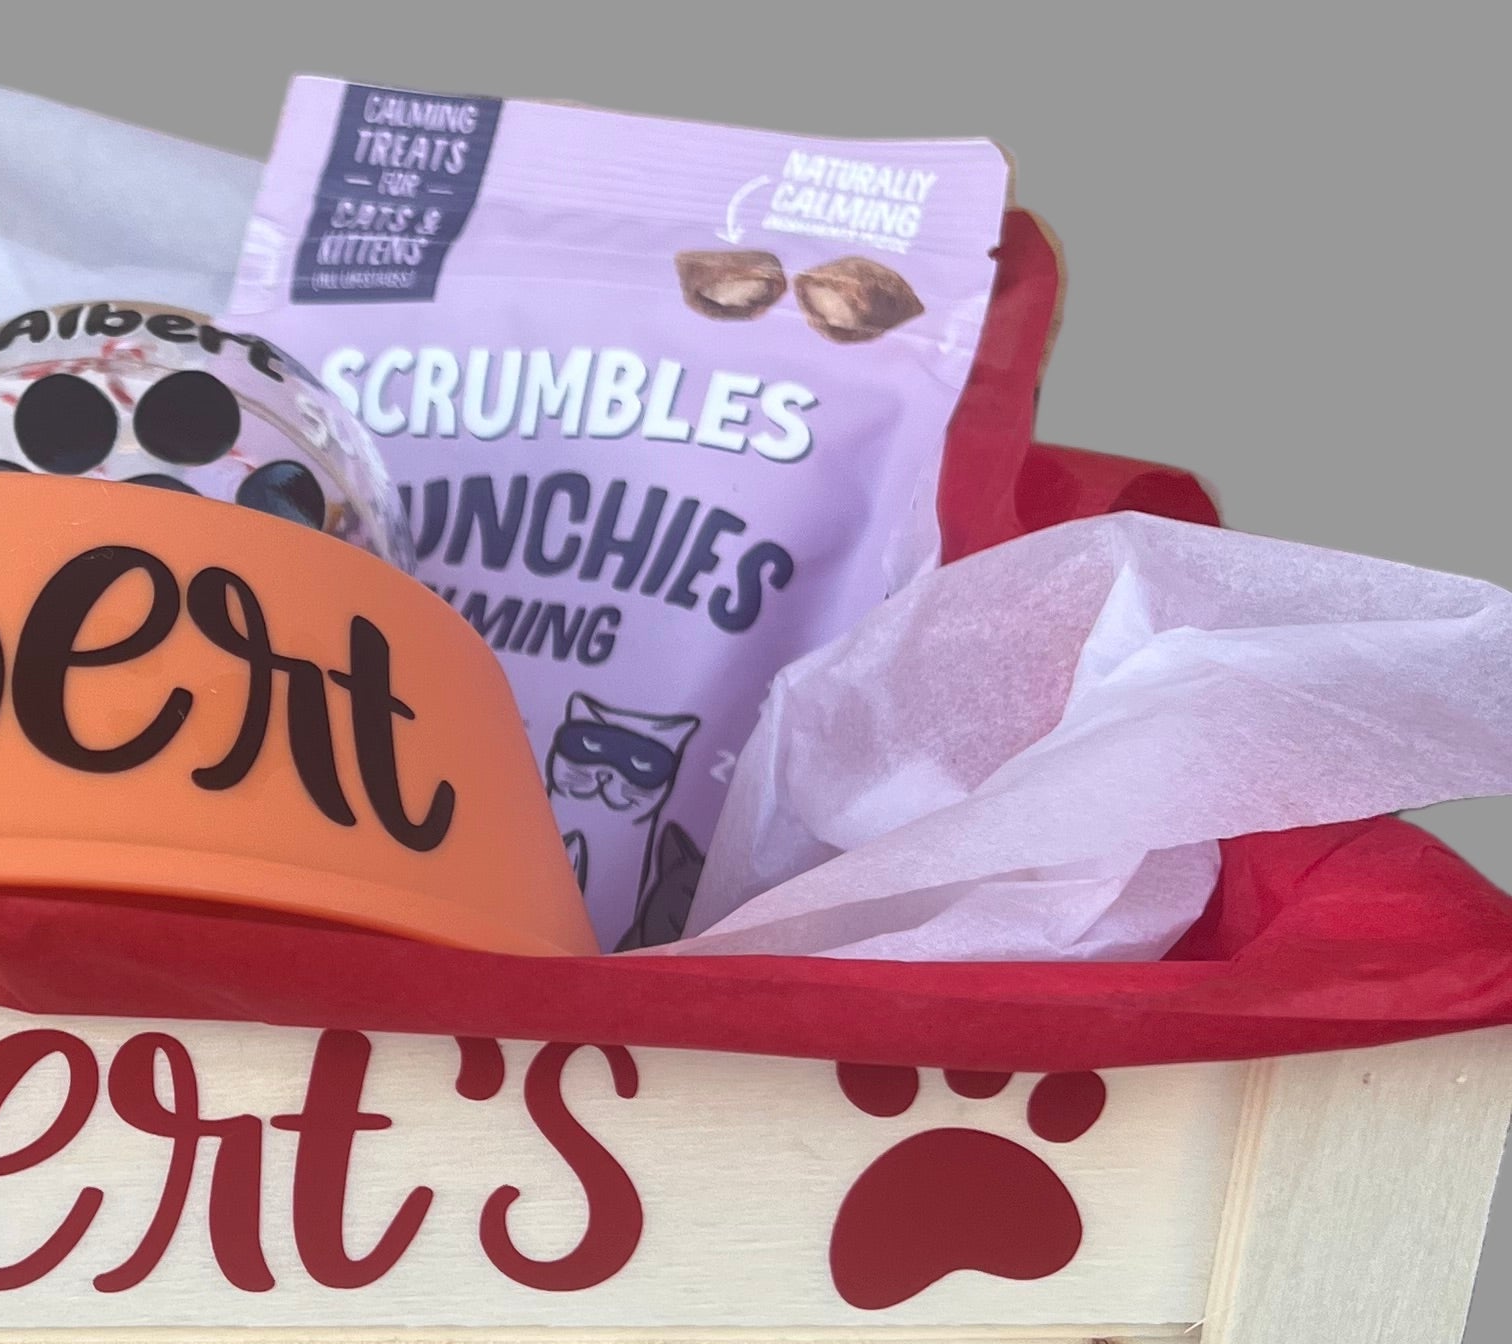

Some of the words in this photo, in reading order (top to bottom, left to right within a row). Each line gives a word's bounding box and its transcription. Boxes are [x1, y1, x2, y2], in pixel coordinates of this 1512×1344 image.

[362, 91, 480, 135] CALMING
[353, 128, 471, 175] TREATS
[377, 170, 422, 199] FOR
[782, 149, 939, 204] NATURALLY
[330, 201, 415, 233] CATS
[414, 207, 442, 236] &
[770, 180, 922, 239] CALMING
[316, 231, 429, 267] KITTENS
[320, 346, 820, 464] SCRUMBLES
[424, 582, 622, 666] MING
